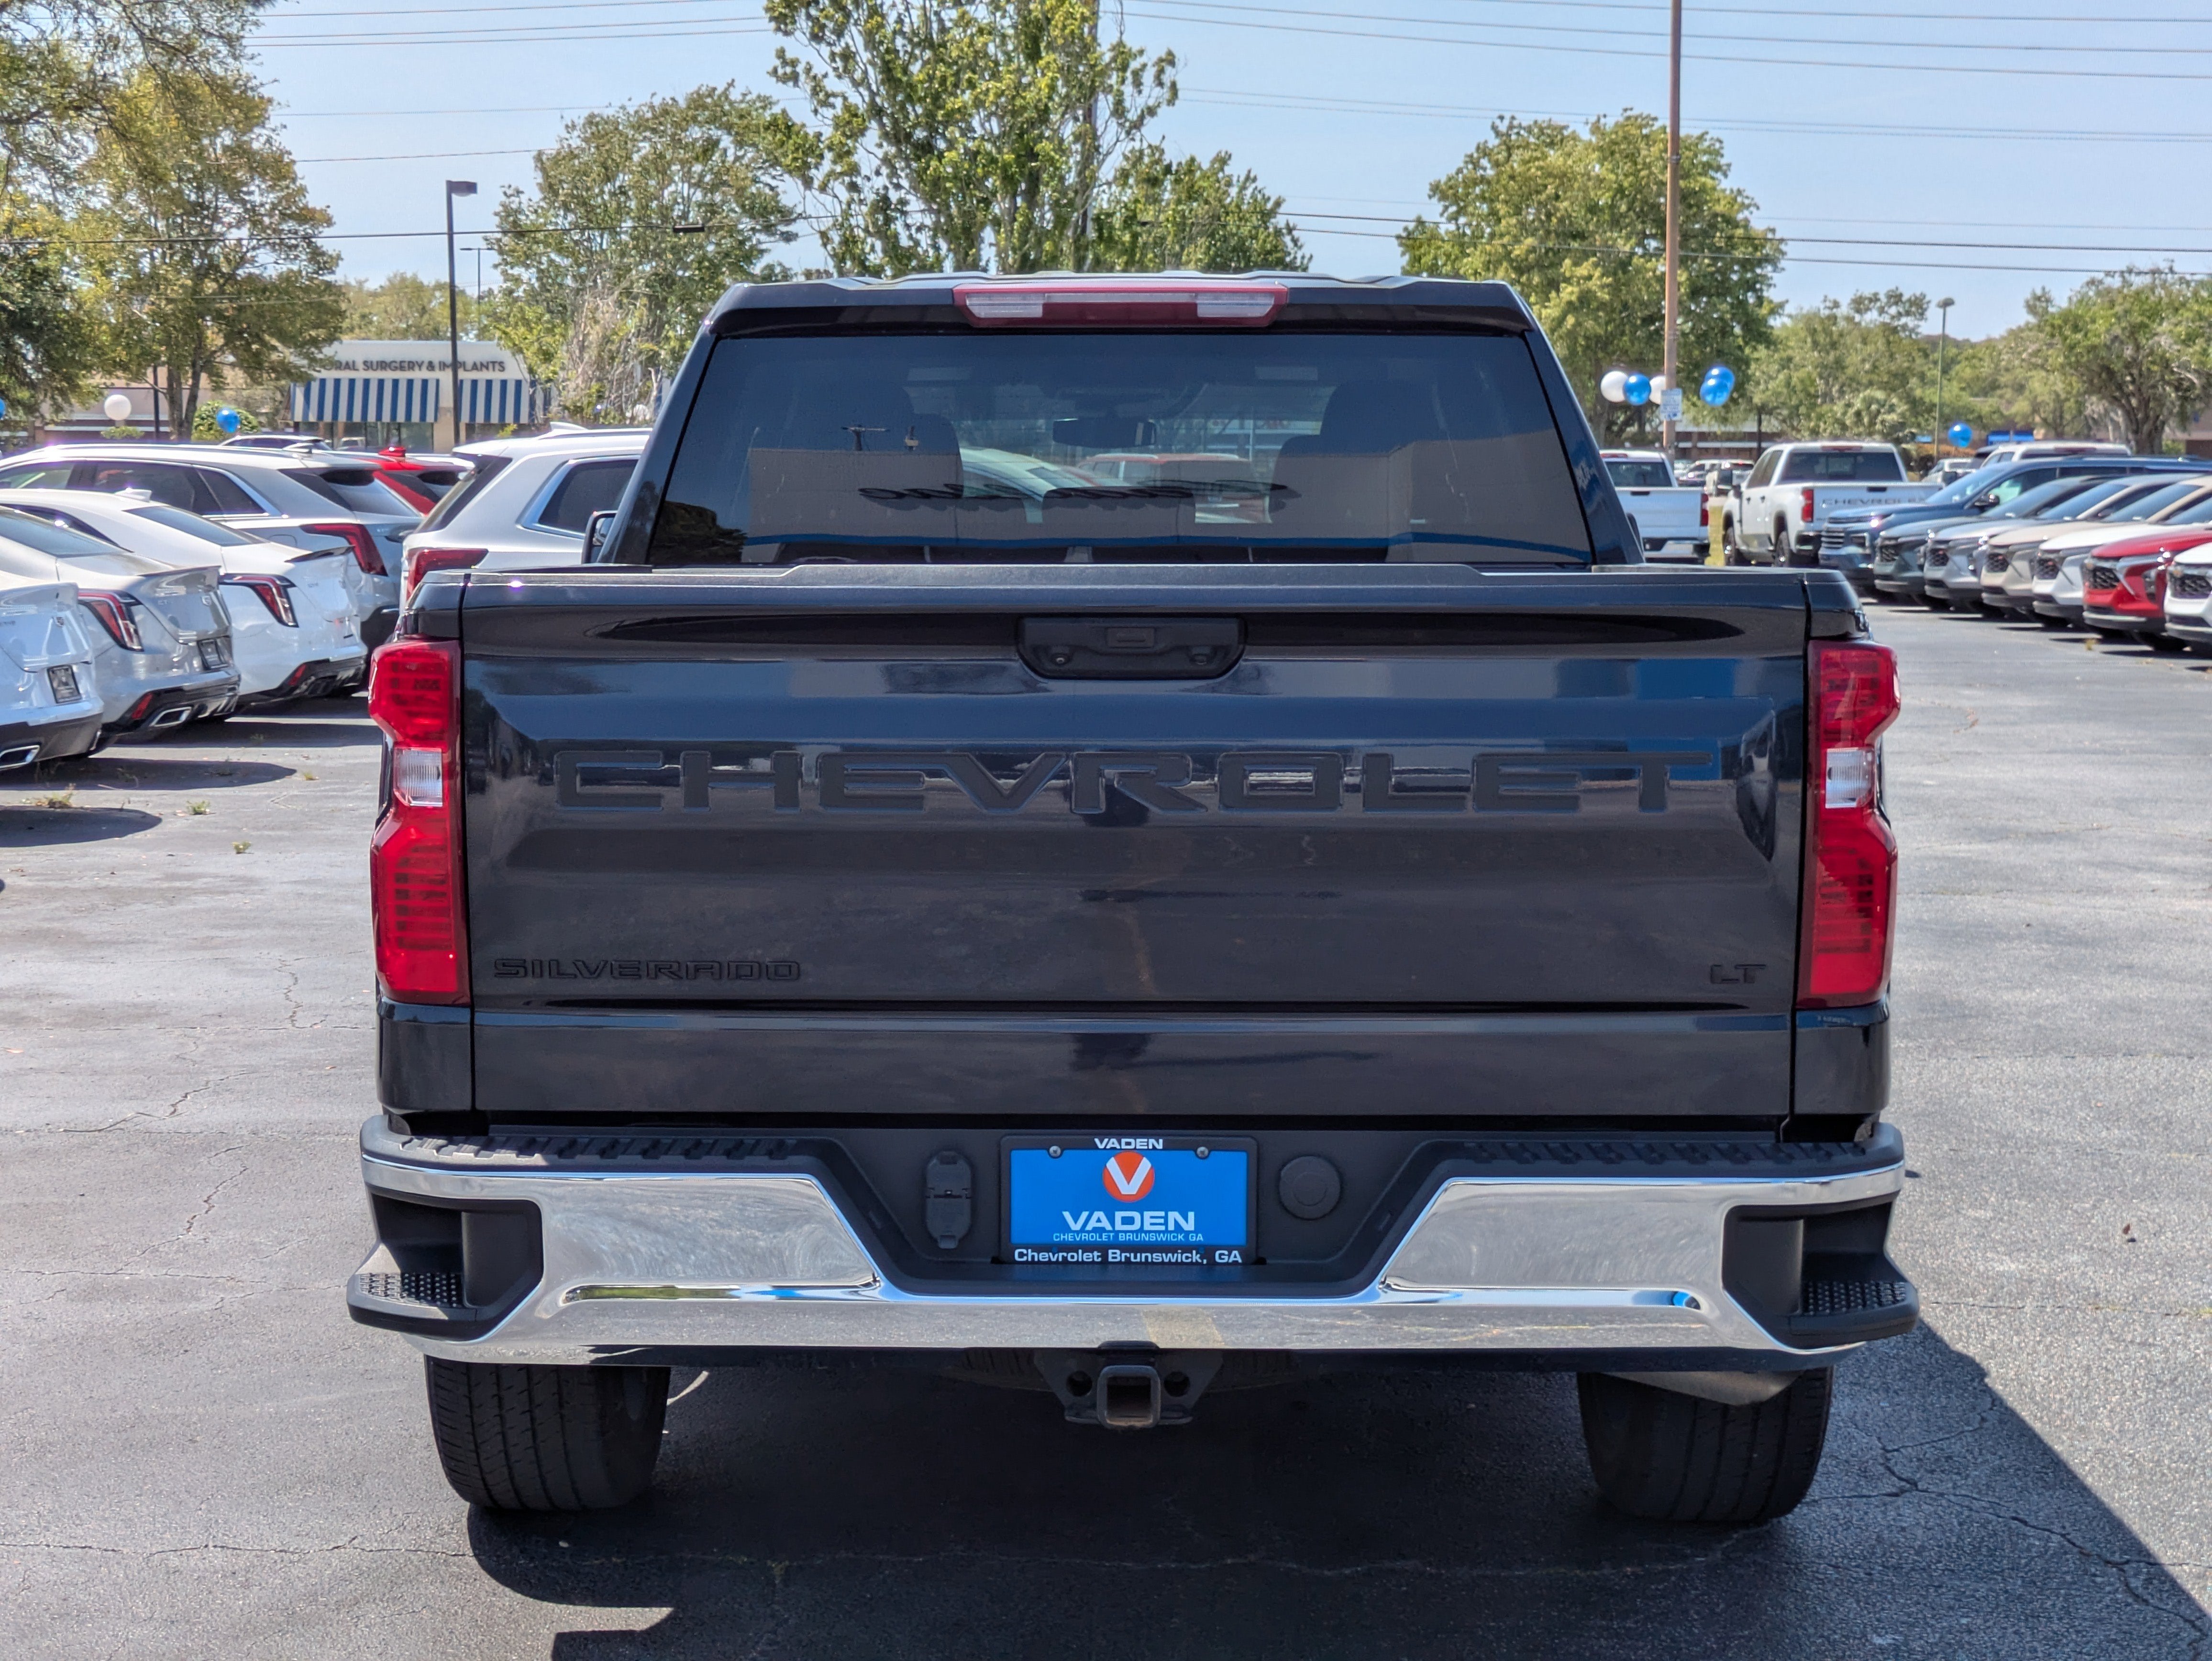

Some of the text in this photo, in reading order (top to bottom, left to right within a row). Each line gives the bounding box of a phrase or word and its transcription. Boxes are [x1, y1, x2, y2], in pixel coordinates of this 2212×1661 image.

[323, 360, 505, 372] RAL SURGERY & IMPLANTS
[554, 750, 1713, 814] CHEVROLET
[493, 958, 801, 981] SILVERADO
[1711, 963, 1766, 984] LT
[1094, 1138, 1163, 1149] VADEN
[1062, 1211, 1195, 1231] VADEN
[1053, 1233, 1204, 1242] CHEVROLET BRUNSWICK GA
[1014, 1249, 1242, 1264] Chevrolet Brunswick, GA
